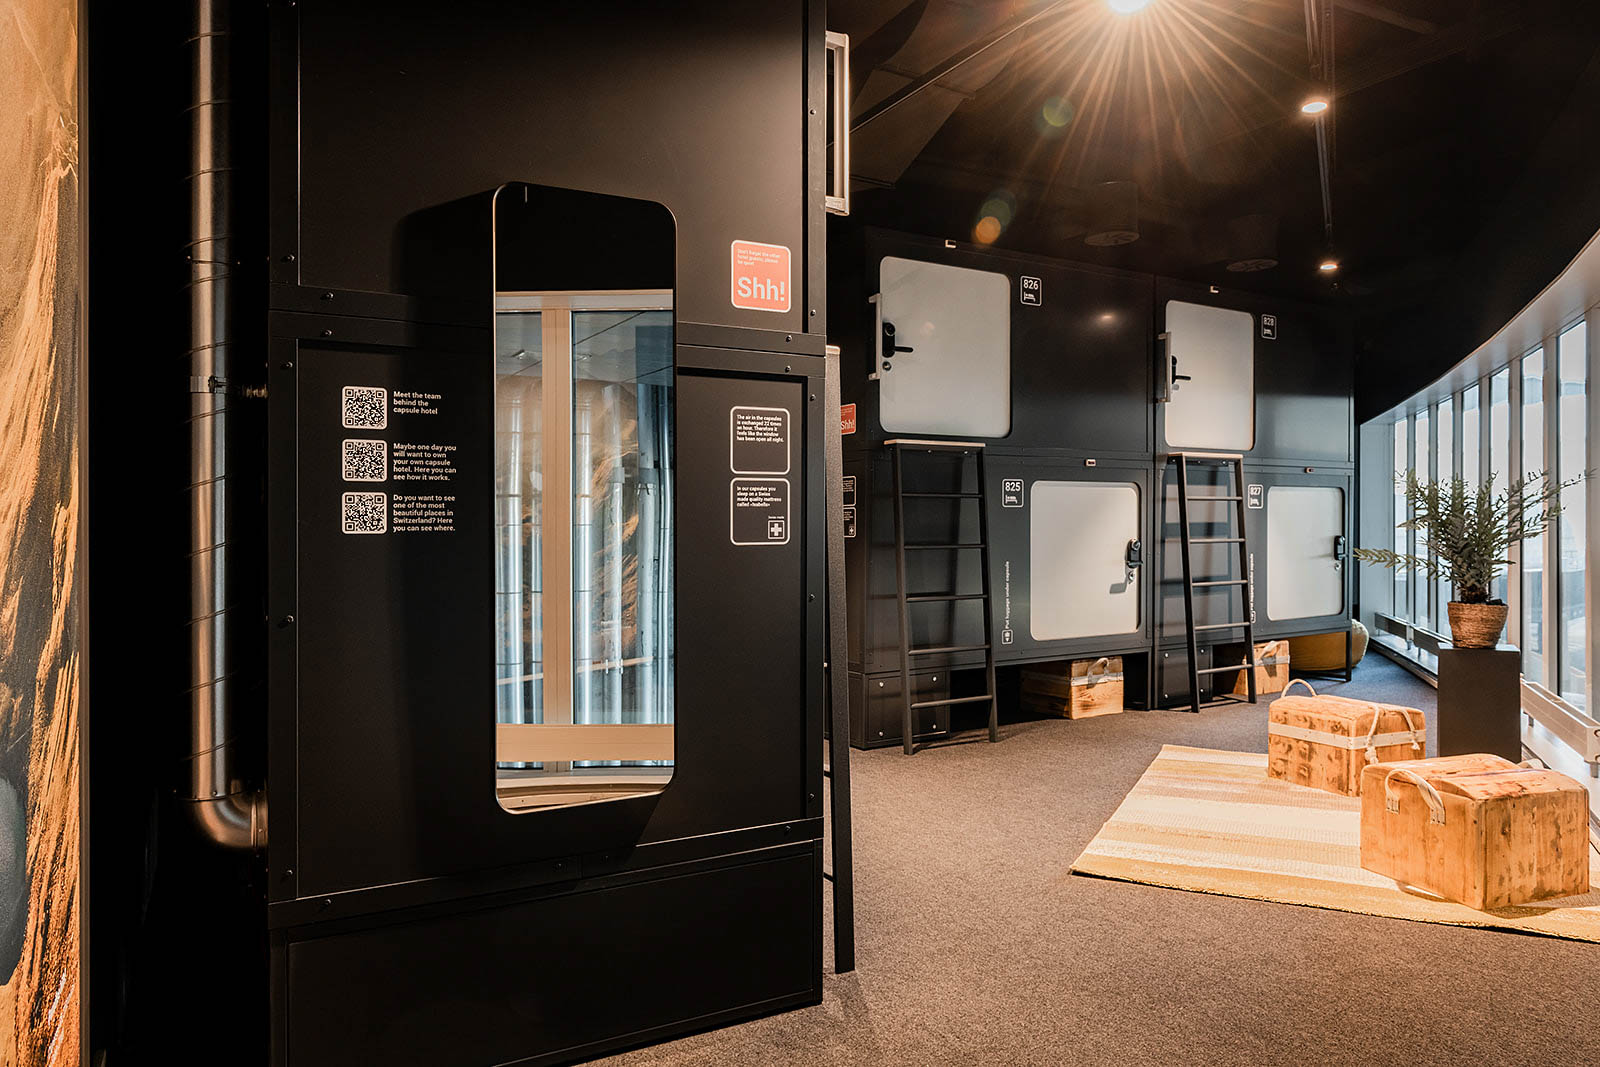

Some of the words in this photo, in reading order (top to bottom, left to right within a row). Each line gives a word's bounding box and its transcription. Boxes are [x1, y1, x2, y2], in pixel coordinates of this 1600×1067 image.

[738, 277, 784, 301] Shh!
[1023, 279, 1038, 290] 826
[431, 444, 443, 452] day
[1005, 482, 1020, 492] 825
[1250, 486, 1261, 495] 827
